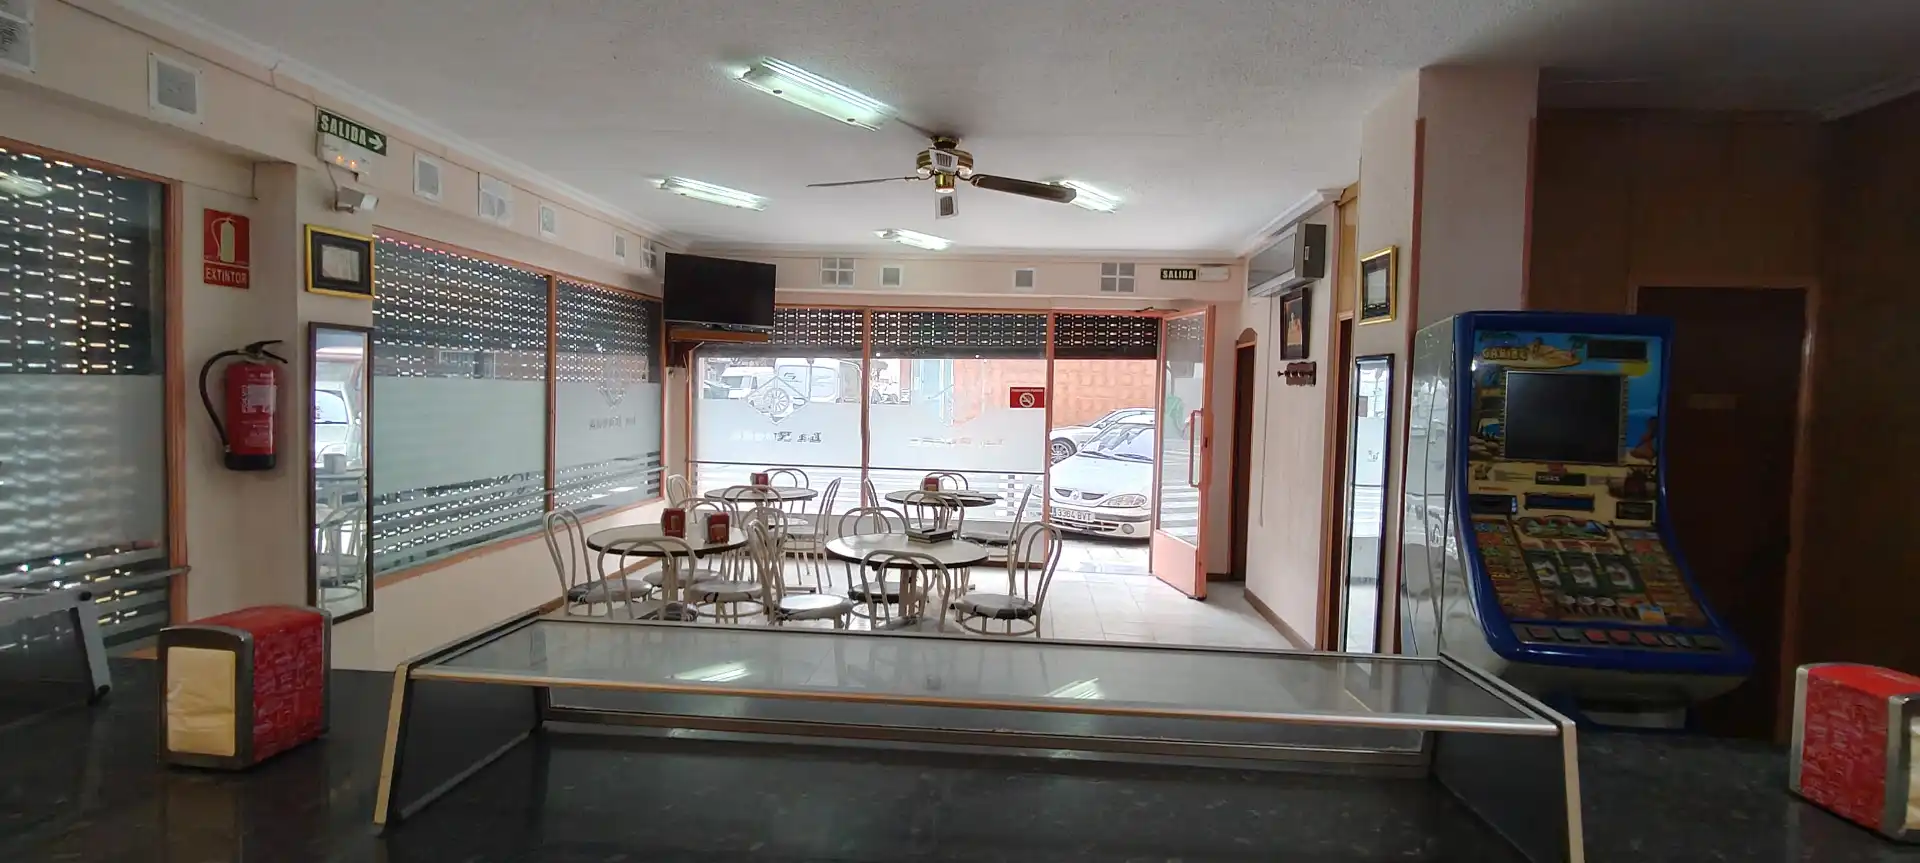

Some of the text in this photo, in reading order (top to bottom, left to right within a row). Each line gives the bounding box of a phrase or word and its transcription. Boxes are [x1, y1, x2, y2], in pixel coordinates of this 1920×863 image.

[320, 114, 367, 146] SALIDA
[205, 267, 248, 284] EXTINTOR
[1162, 269, 1194, 279] SALIDA
